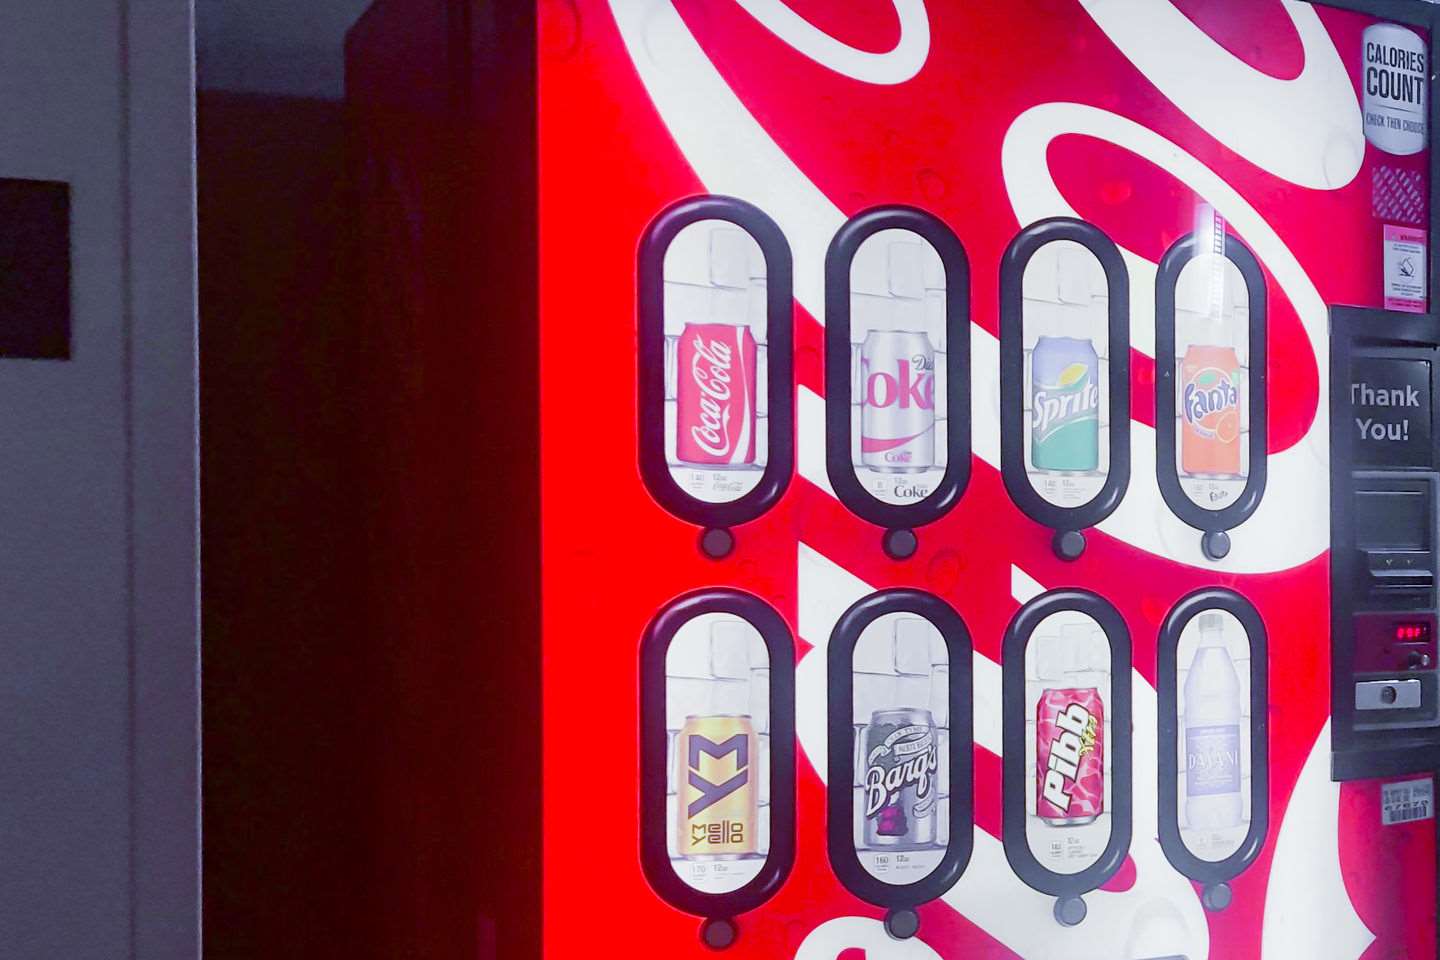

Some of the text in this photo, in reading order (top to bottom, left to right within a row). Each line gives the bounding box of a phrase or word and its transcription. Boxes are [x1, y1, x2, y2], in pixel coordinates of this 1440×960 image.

[1366, 42, 1424, 73] CALORIES
[1366, 66, 1424, 105] COUNT
[1033, 376, 1098, 428] Sprite
[1184, 378, 1237, 424] Fanta
[1351, 382, 1420, 407] Thank
[1355, 418, 1409, 441] You!
[894, 485, 928, 498] Coke
[1042, 703, 1090, 813] Pibb
[865, 744, 937, 816] Barq's
